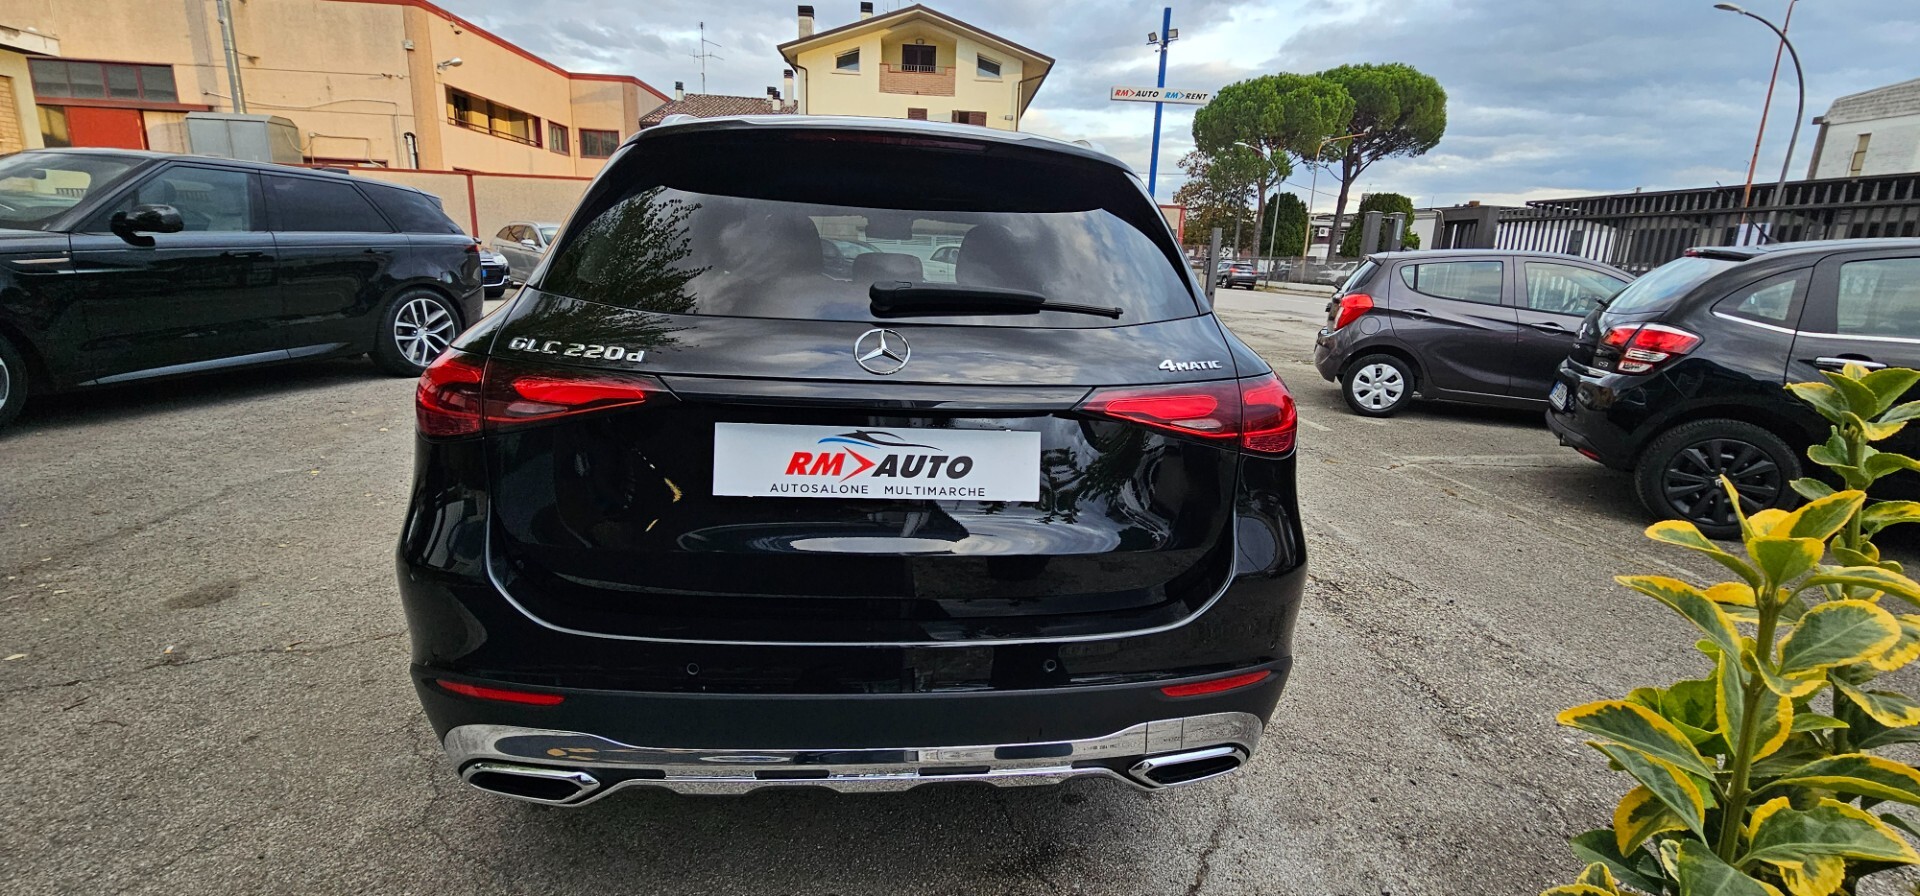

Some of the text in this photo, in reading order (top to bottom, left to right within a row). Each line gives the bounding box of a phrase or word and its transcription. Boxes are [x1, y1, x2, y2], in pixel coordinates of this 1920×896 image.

[508, 337, 645, 363] GLC 220d
[1159, 359, 1223, 372] 4MATIC
[871, 454, 974, 480] AUTO
[770, 483, 986, 497] AUTOSALONE MULTIMARCHE
